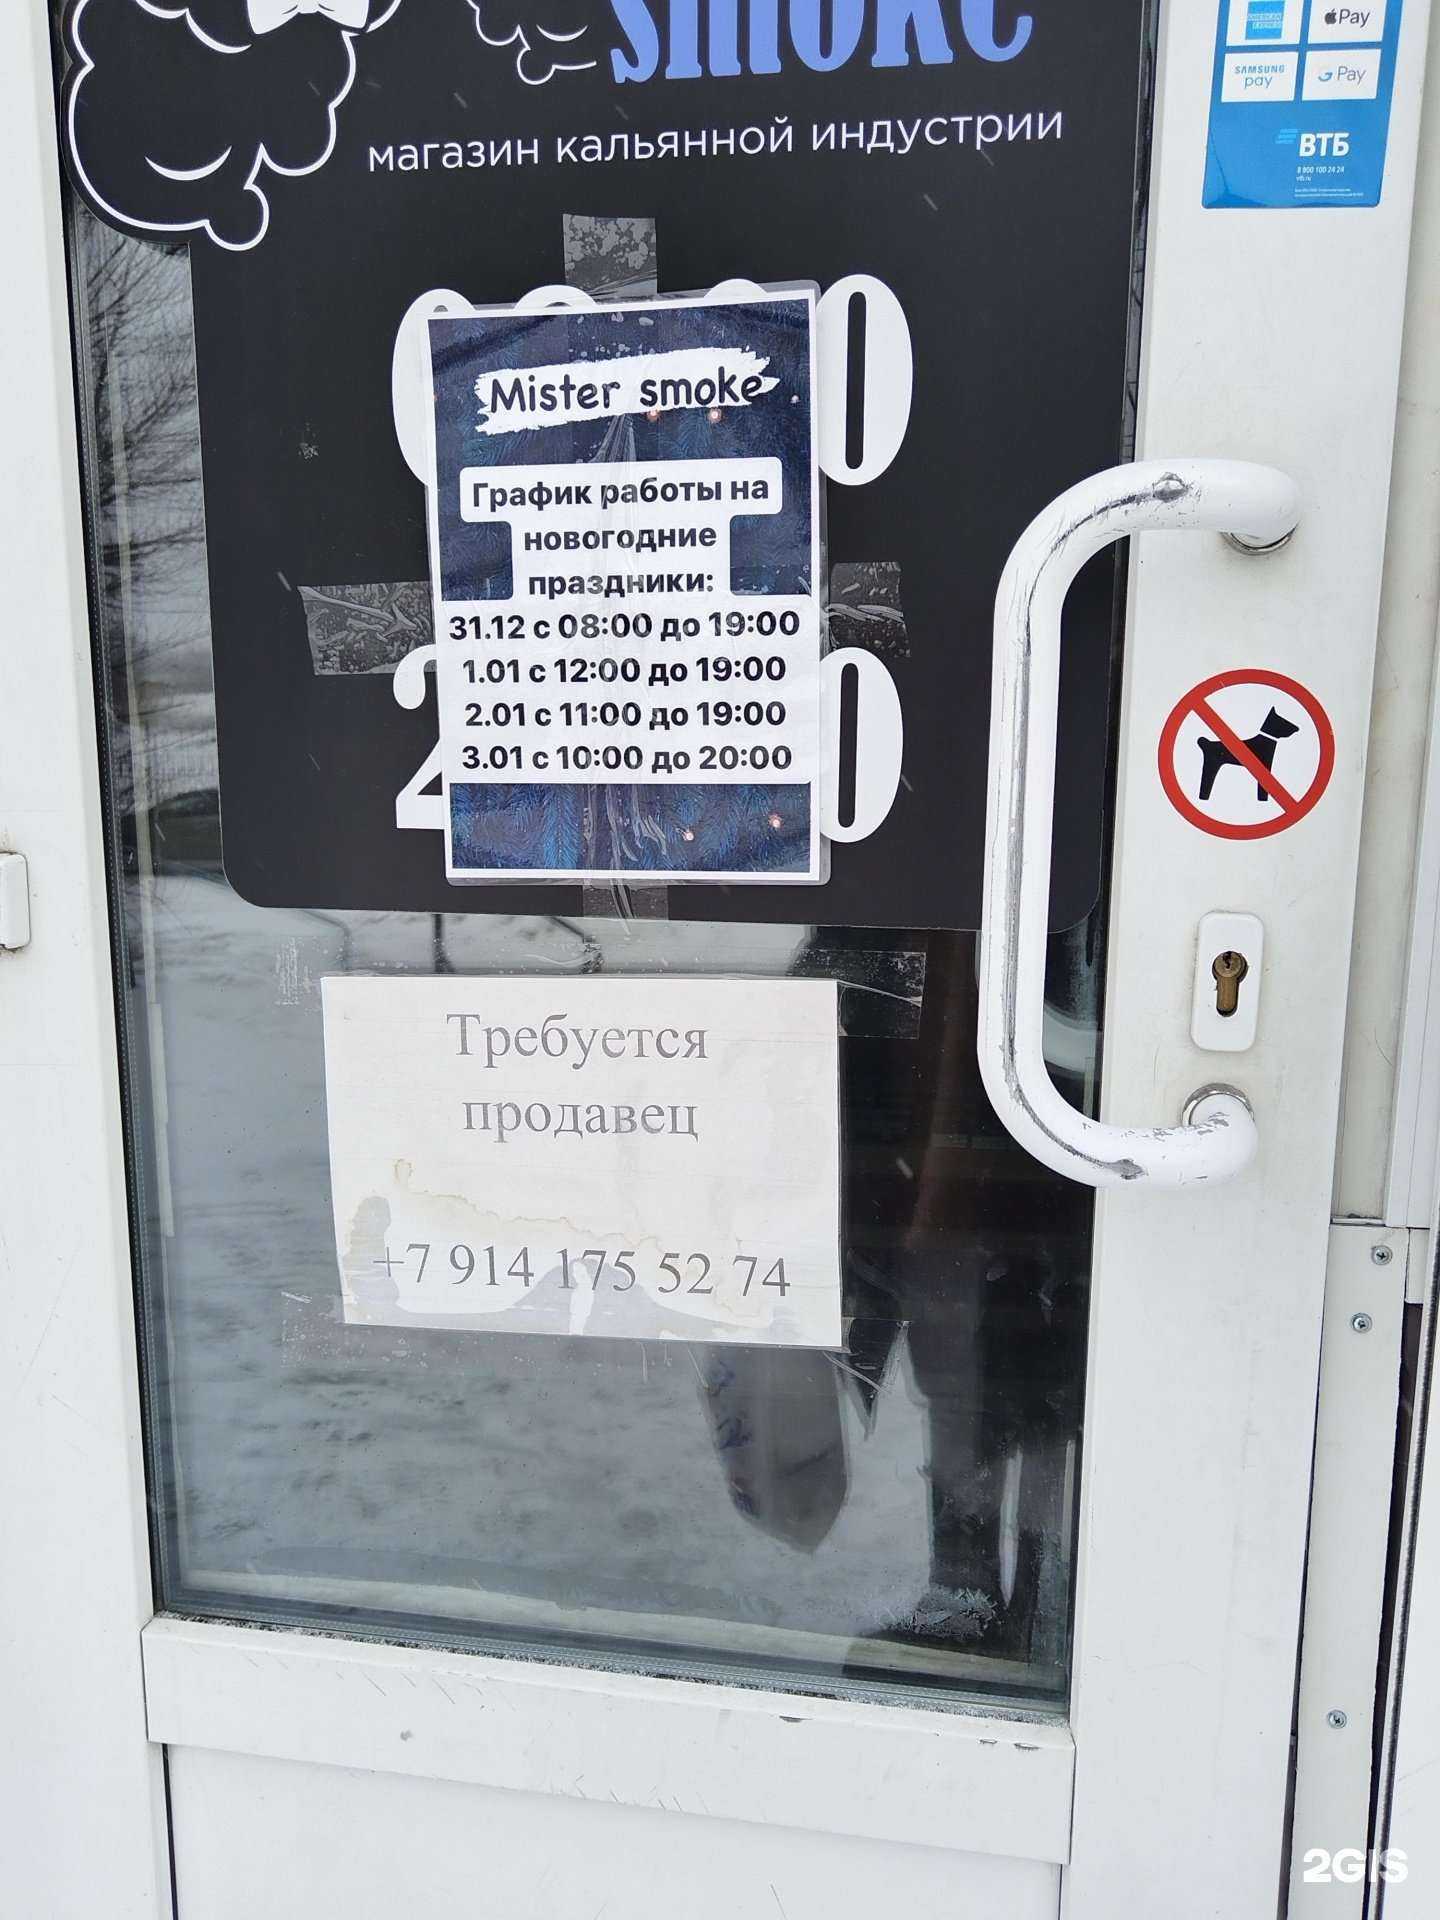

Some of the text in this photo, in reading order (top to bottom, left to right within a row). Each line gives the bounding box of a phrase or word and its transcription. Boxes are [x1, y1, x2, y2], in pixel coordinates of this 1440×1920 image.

[1339, 8, 1370, 28] Pay
[1234, 64, 1285, 74] SAMSUNG
[1244, 75, 1273, 89] pay
[1337, 65, 1367, 86] Pay
[369, 111, 1062, 172] магазин кальянной индустрии
[1299, 132, 1350, 157] ВТБ
[490, 366, 764, 414] Mister smoke
[473, 478, 769, 509] График работы на
[523, 525, 717, 553] новогодние
[528, 570, 714, 600] праздники:
[449, 610, 801, 643] 31.12 с 08:00 до 19:00
[463, 655, 787, 687] 1.01 с 12:00 до 19:00
[464, 700, 787, 731] 2.01 с 11:00 до 19:00
[461, 744, 793, 774] 3.01 с 10:00 до 20:00
[446, 1013, 709, 1070] Требуется
[462, 1101, 699, 1143] продавец
[373, 1243, 791, 1298] +7 914 175 52 74
